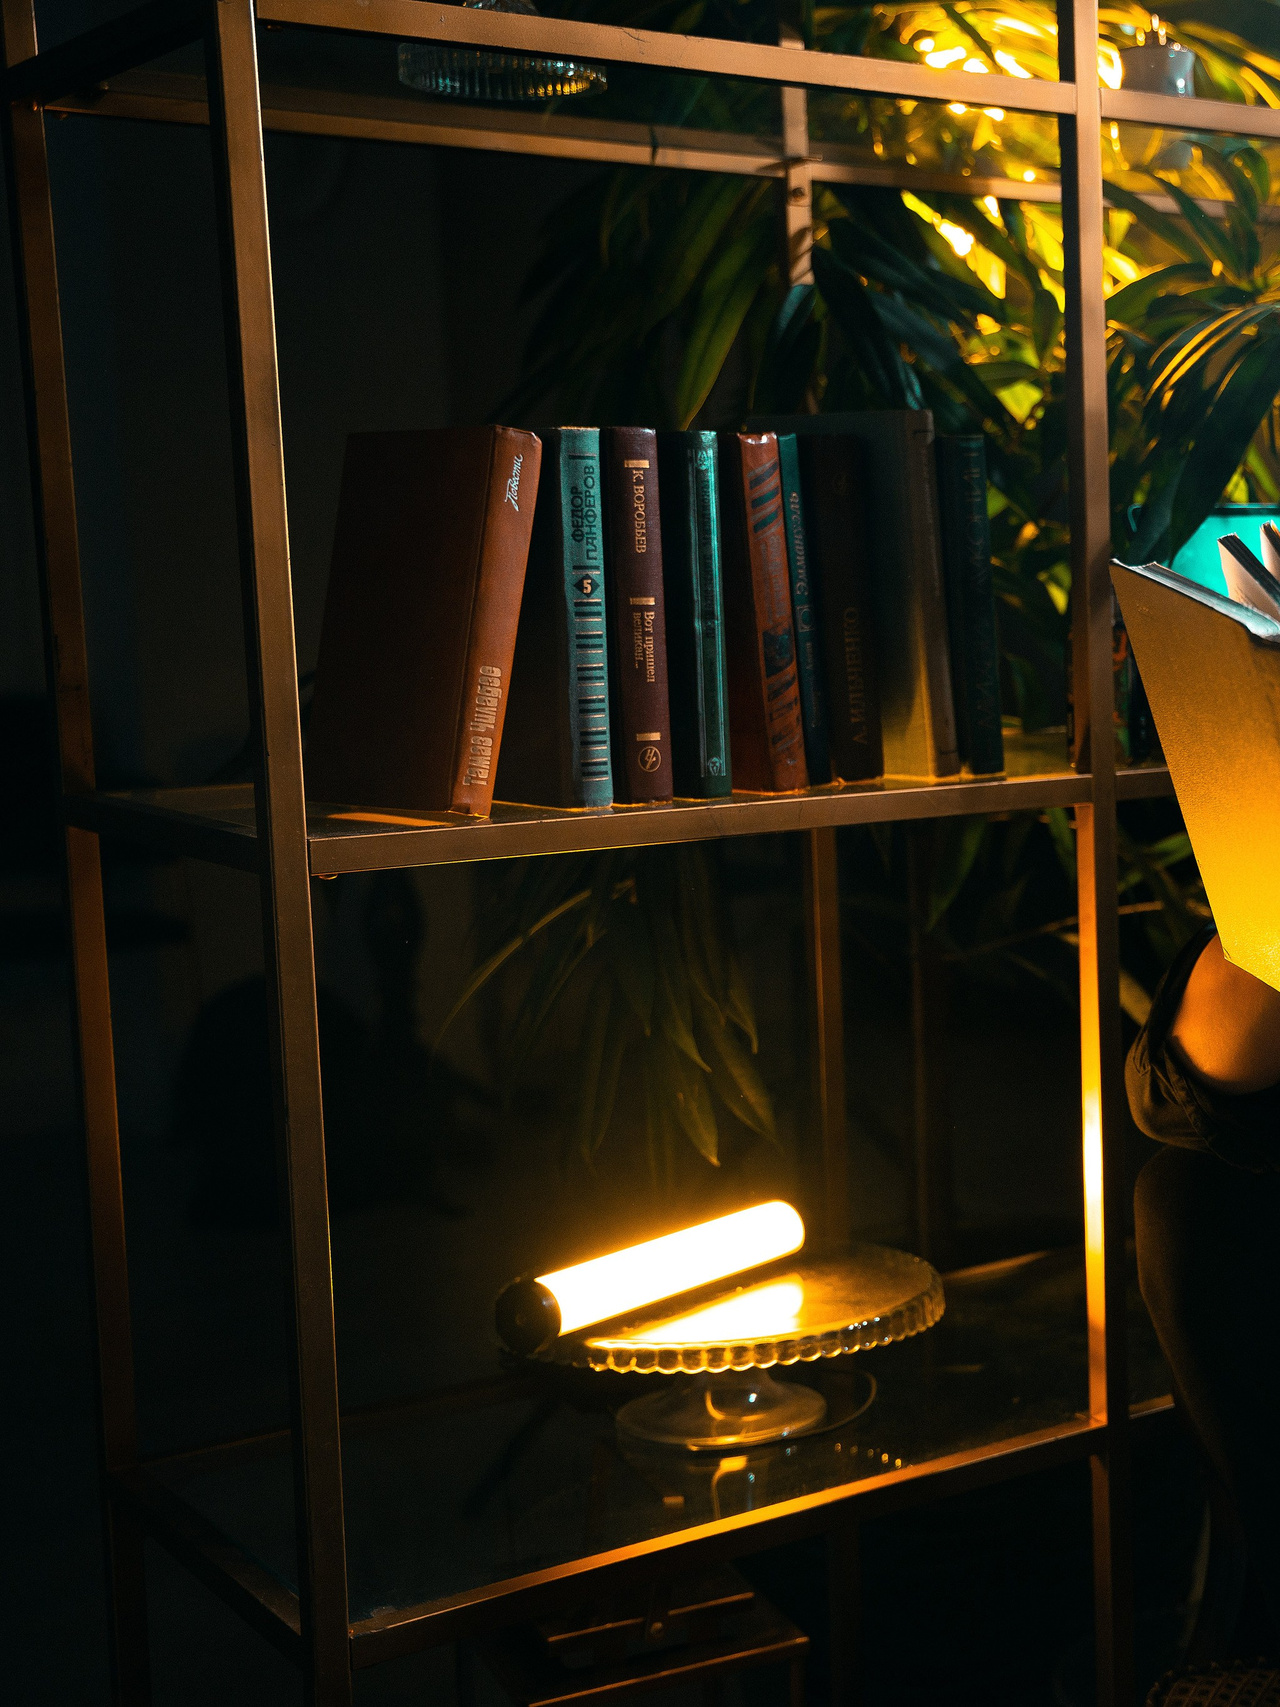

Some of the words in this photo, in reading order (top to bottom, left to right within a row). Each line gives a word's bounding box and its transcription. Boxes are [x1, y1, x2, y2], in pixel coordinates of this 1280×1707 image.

[504, 454, 524, 512] Повести
[632, 469, 645, 482] К.
[570, 486, 586, 543] ФЕДОР
[585, 464, 599, 561] ПАНФЕРОВ
[633, 484, 647, 554] ВОРОБЬЕВ
[582, 579, 593, 595] 5
[644, 611, 655, 633] Вот
[645, 637, 657, 683] пришел
[469, 665, 502, 732] Чиладзе
[462, 736, 493, 786] Тамаз
